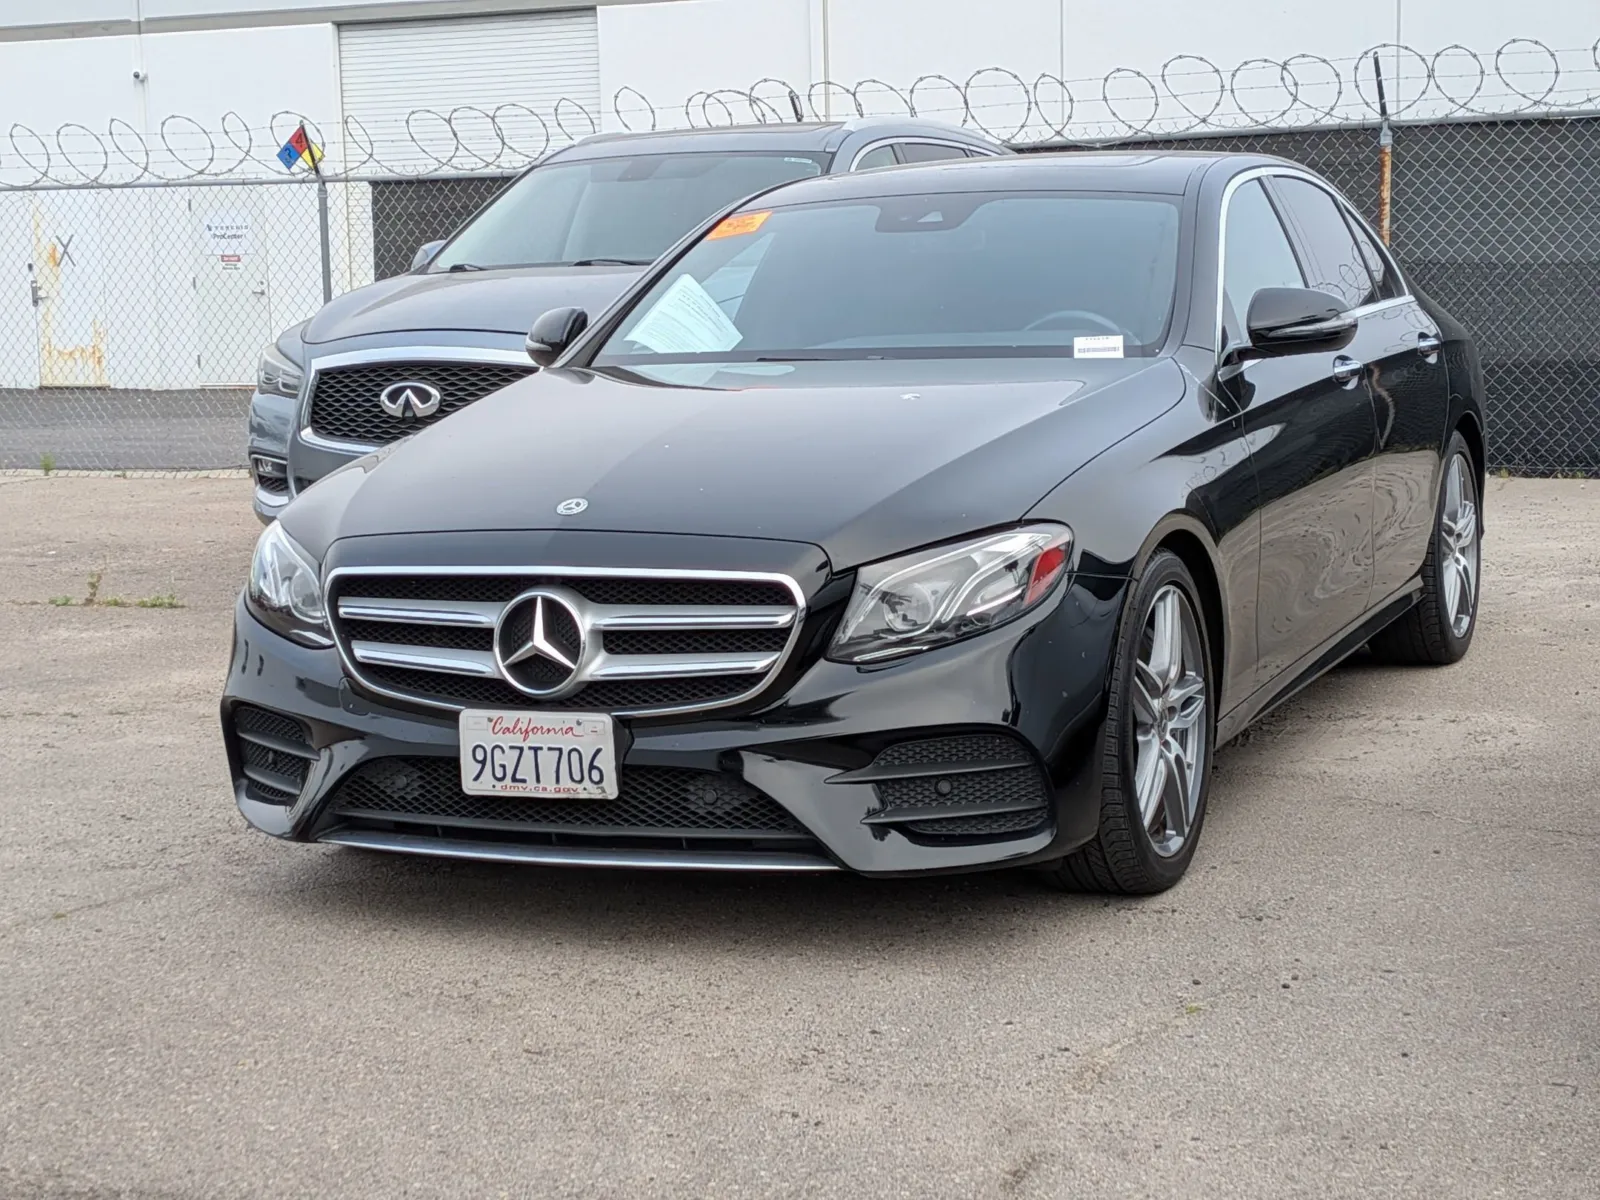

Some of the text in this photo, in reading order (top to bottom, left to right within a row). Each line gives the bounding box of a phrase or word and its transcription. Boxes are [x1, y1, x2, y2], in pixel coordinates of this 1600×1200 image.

[295, 133, 303, 149] 4
[491, 716, 584, 742] California
[472, 744, 605, 785] 9GZT706
[500, 784, 579, 793] dmv.ca.gov
